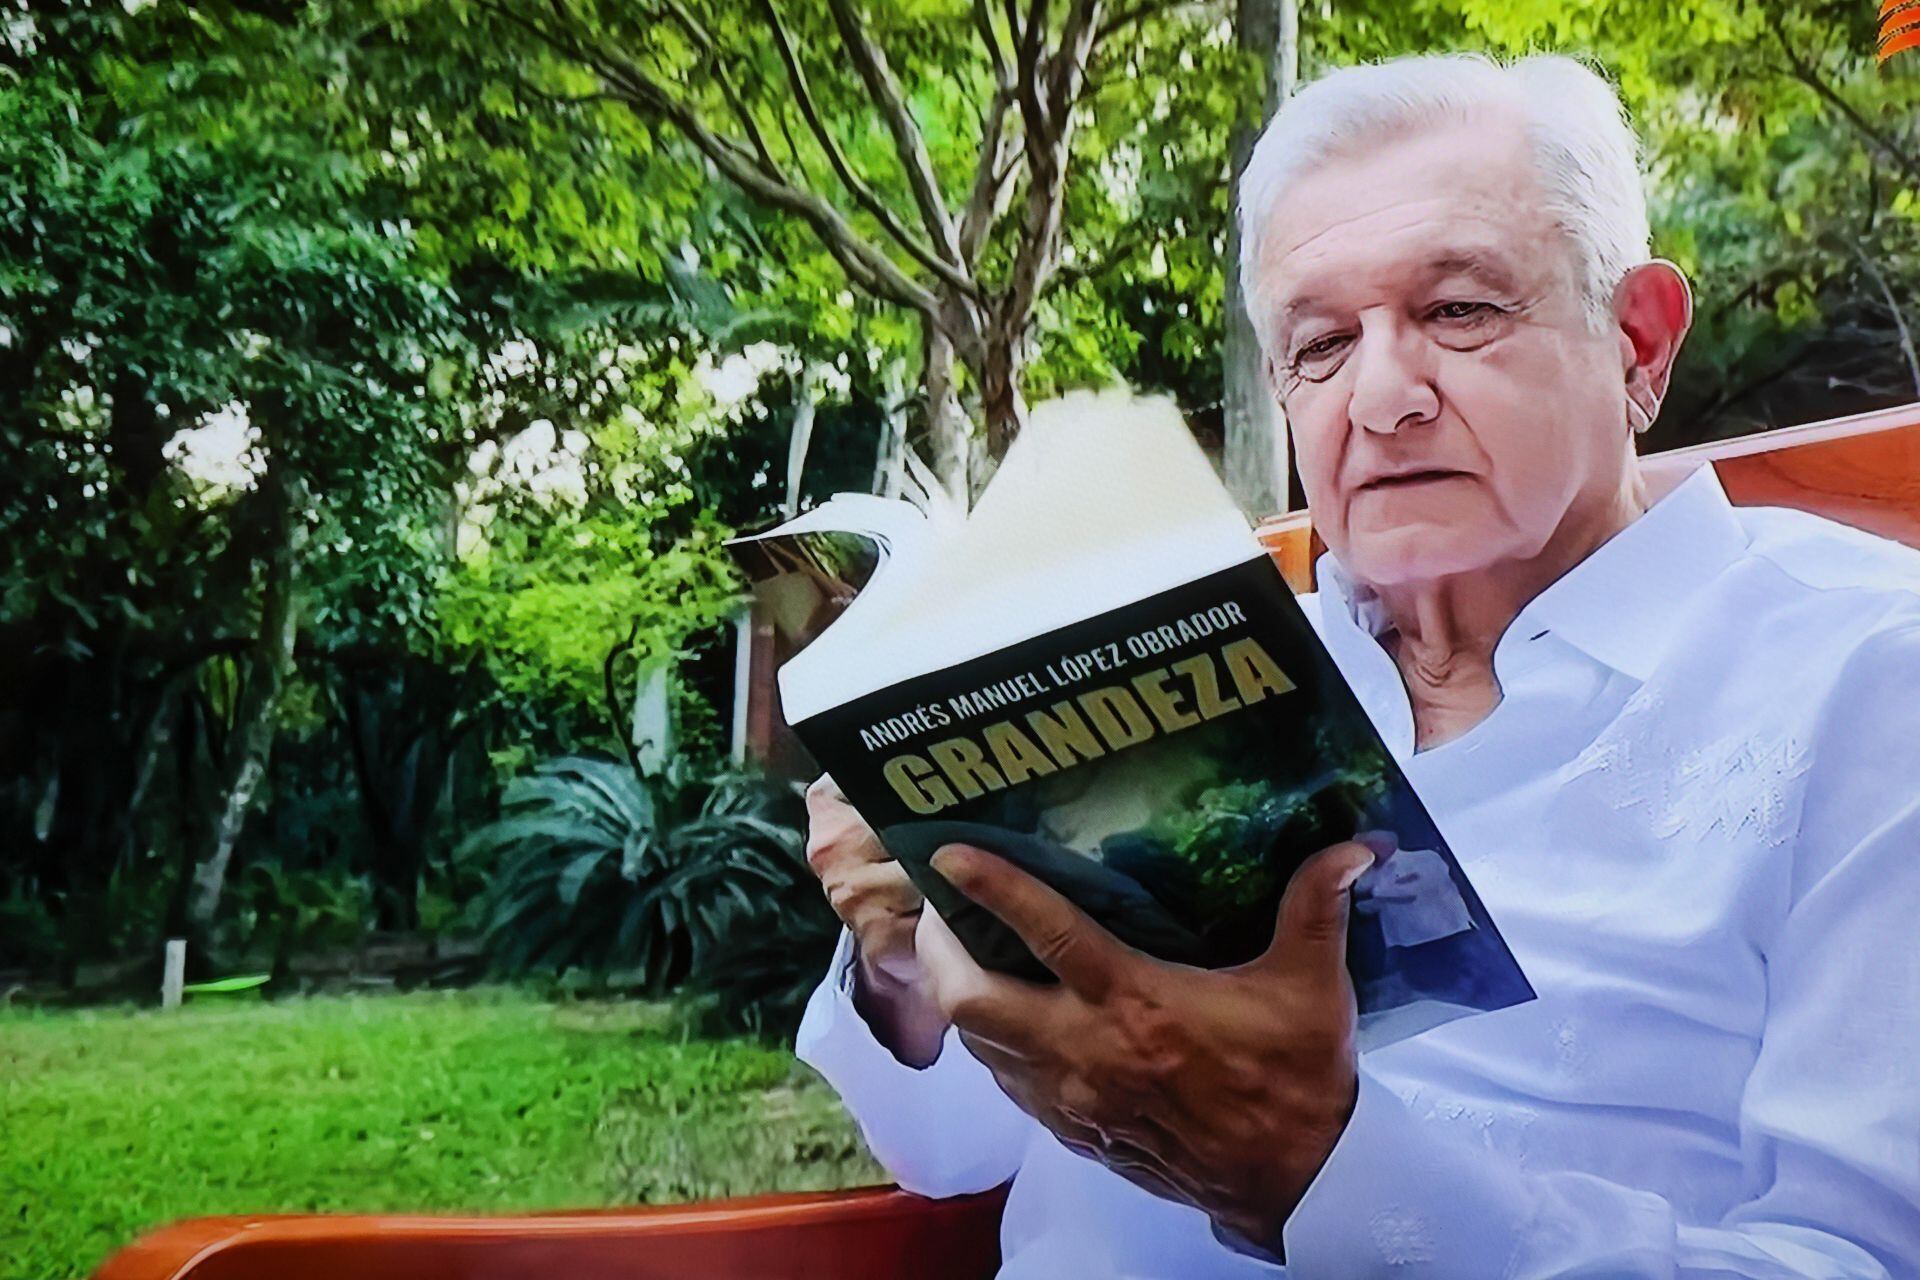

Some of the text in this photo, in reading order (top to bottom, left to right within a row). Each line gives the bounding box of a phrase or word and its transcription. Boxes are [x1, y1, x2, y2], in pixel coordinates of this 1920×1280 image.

[860, 600, 1248, 751] ANDRÉS MANUEL LÓPEZ OBRADOR
[883, 637, 1297, 814] GRANDEZA
